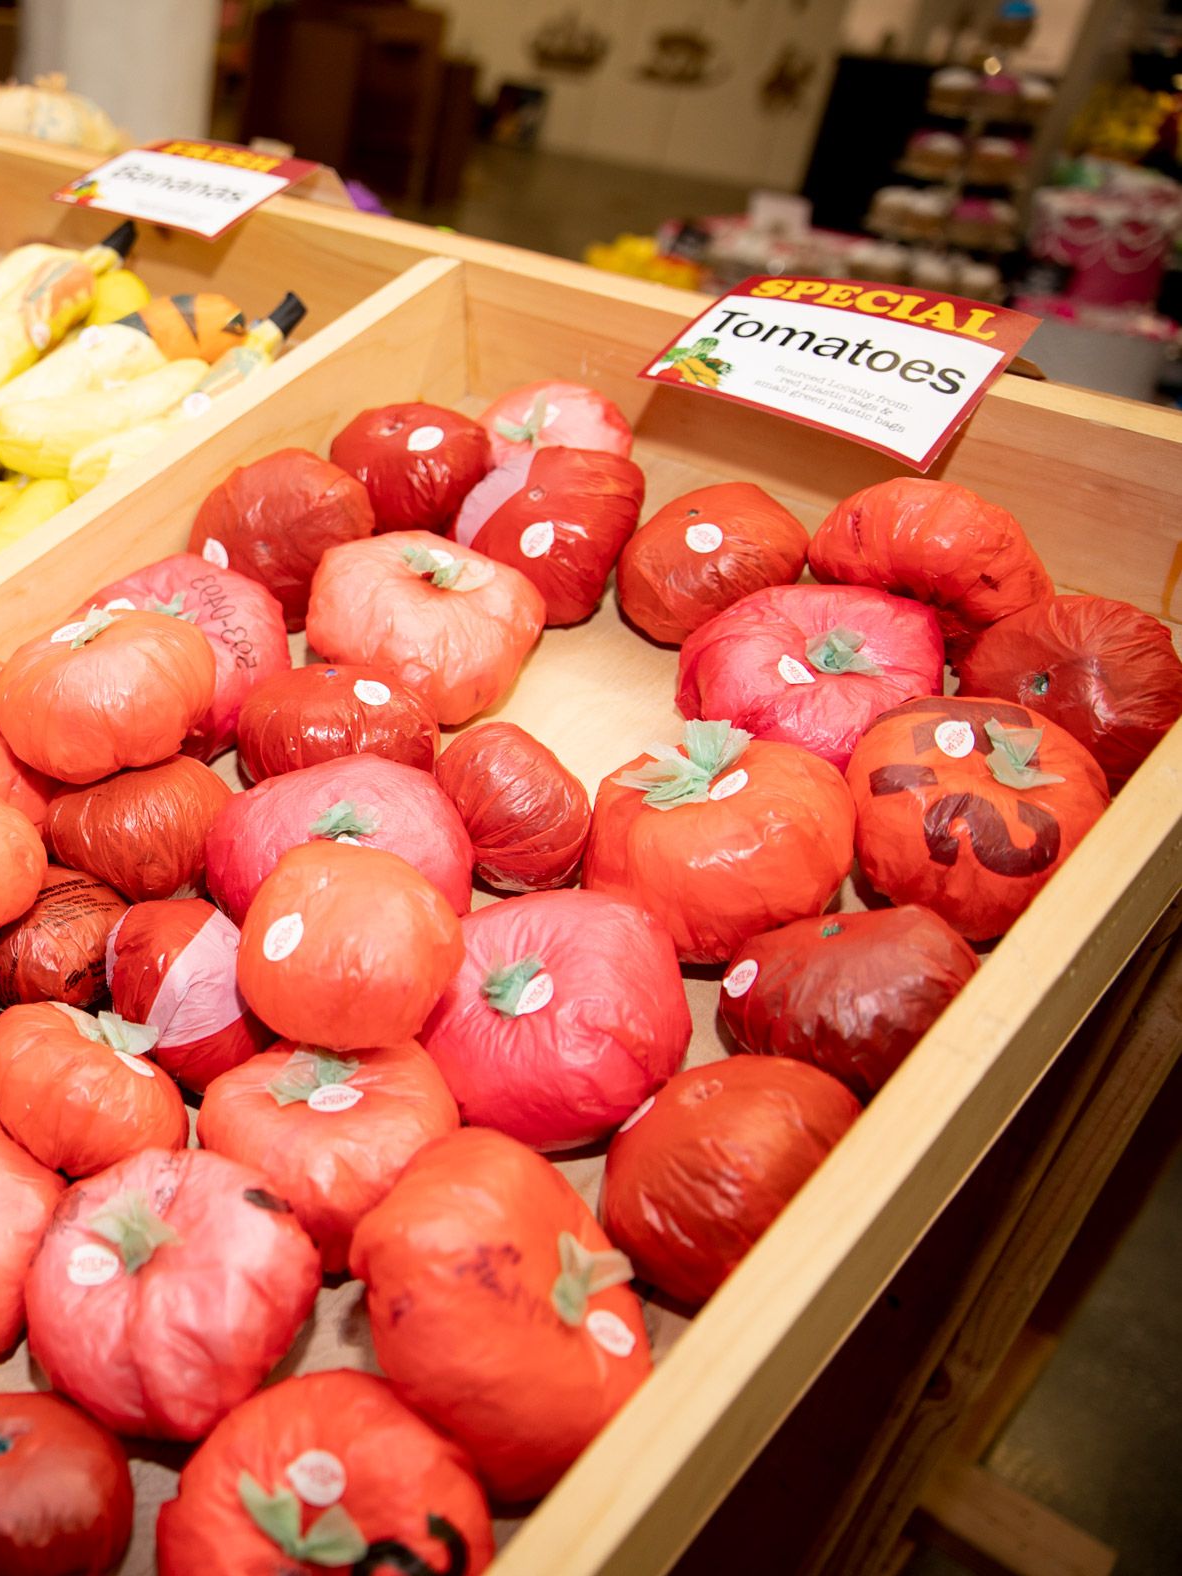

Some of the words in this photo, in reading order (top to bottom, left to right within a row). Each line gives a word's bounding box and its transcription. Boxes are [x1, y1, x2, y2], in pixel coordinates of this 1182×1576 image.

[110, 161, 243, 204] Bananas
[750, 278, 997, 341] SPECIAL
[712, 309, 968, 396] Tomatoes
[754, 378, 788, 394] small
[789, 388, 827, 406] green
[827, 400, 871, 421] plastic
[873, 414, 906, 434] bags
[804, 382, 845, 401] plastic
[848, 394, 878, 412] bags
[880, 406, 893, 416] &
[828, 378, 875, 399] Locally
